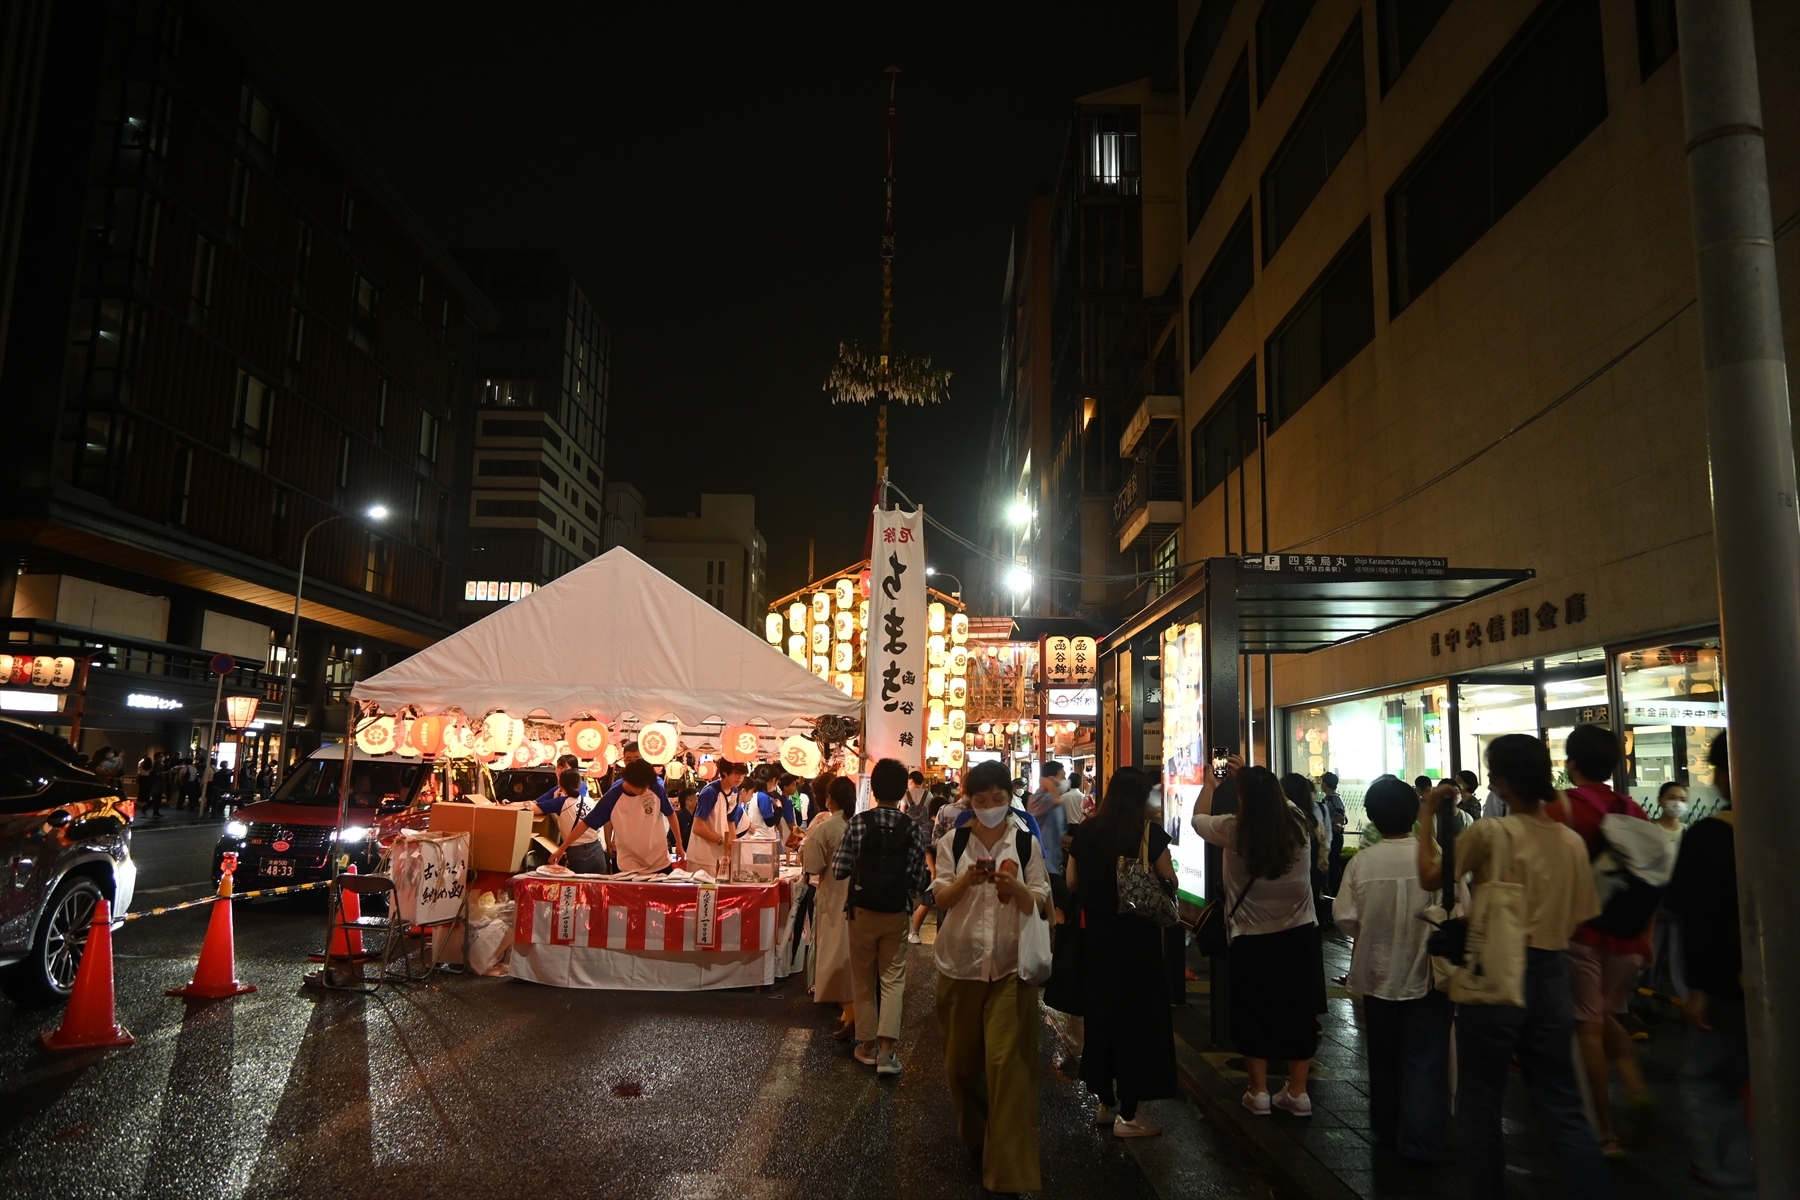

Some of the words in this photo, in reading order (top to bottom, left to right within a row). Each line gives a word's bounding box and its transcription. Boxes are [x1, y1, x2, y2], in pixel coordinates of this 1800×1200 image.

[1269, 556, 1276, 565] F
[1288, 556, 1347, 567] 四条烏丸
[1354, 557, 1367, 566] Shijo
[1395, 558, 1417, 567] (Subway
[1418, 559, 1432, 568] Shijo
[1054, 639, 1067, 675] 函谷鉾
[1075, 639, 1087, 675] 函谷鉾
[127, 693, 183, 710] センター
[266, 865, 293, 876] 48-33
